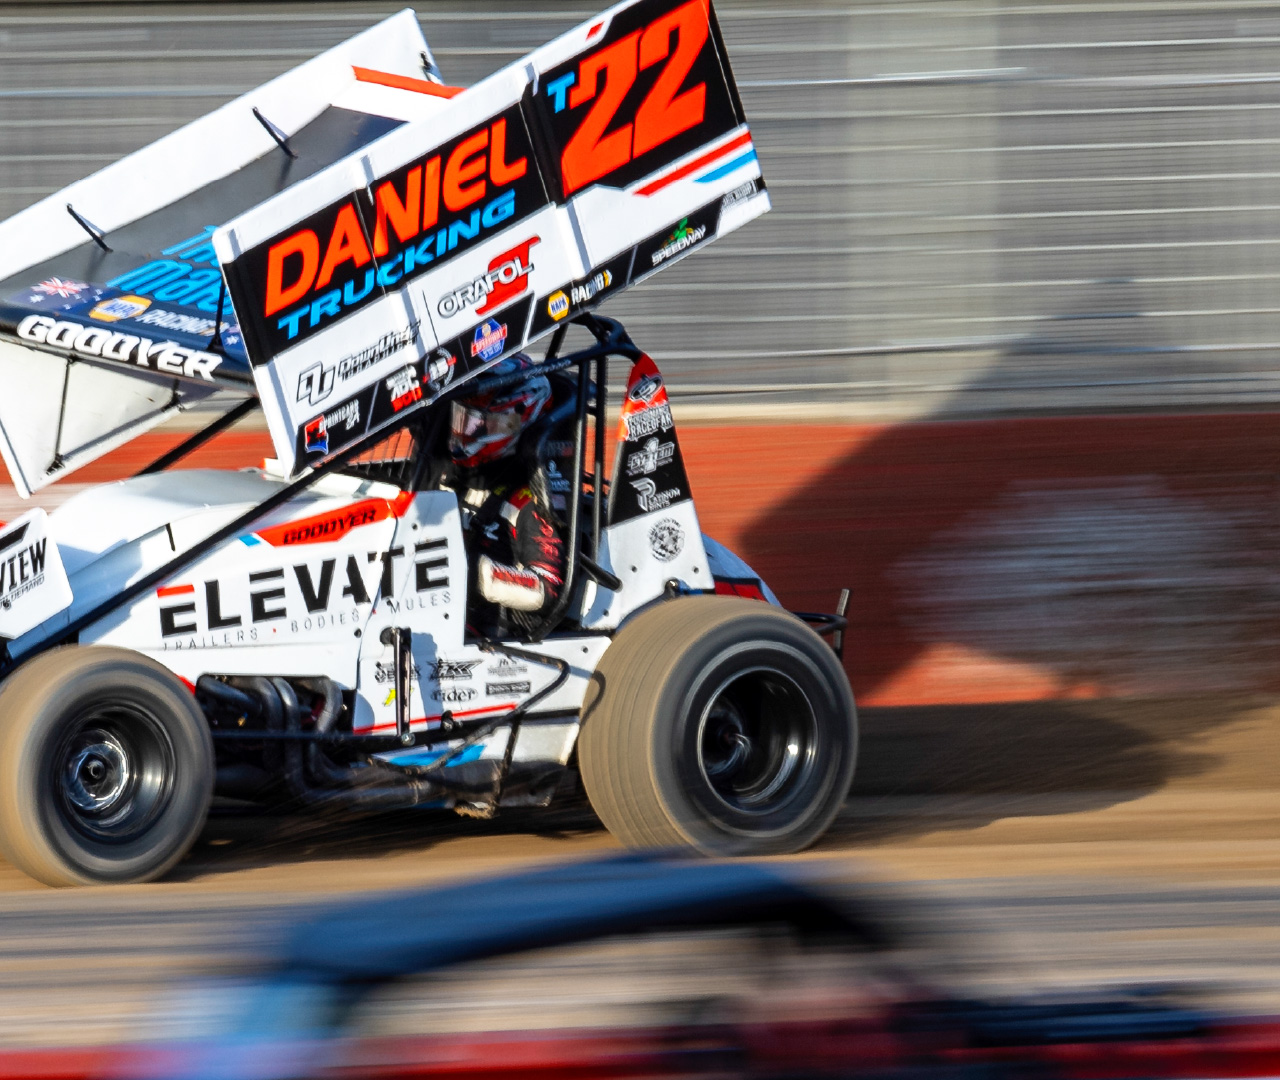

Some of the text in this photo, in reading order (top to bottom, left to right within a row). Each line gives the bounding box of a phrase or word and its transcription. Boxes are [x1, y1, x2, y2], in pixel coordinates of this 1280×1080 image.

[265, 116, 527, 318] DANIEL
[652, 225, 706, 266] SPEEDWAY
[278, 188, 515, 340] TRUCKING
[438, 256, 535, 318] ORAFOL
[551, 273, 604, 313] NAPA RACING
[17, 315, 222, 382] GOODYER
[283, 509, 376, 545] GOODYER
[11, 575, 45, 601] DEMAND
[156, 537, 450, 638] ELEVATE
[161, 590, 451, 651] TRAILERS BODIES MULES
